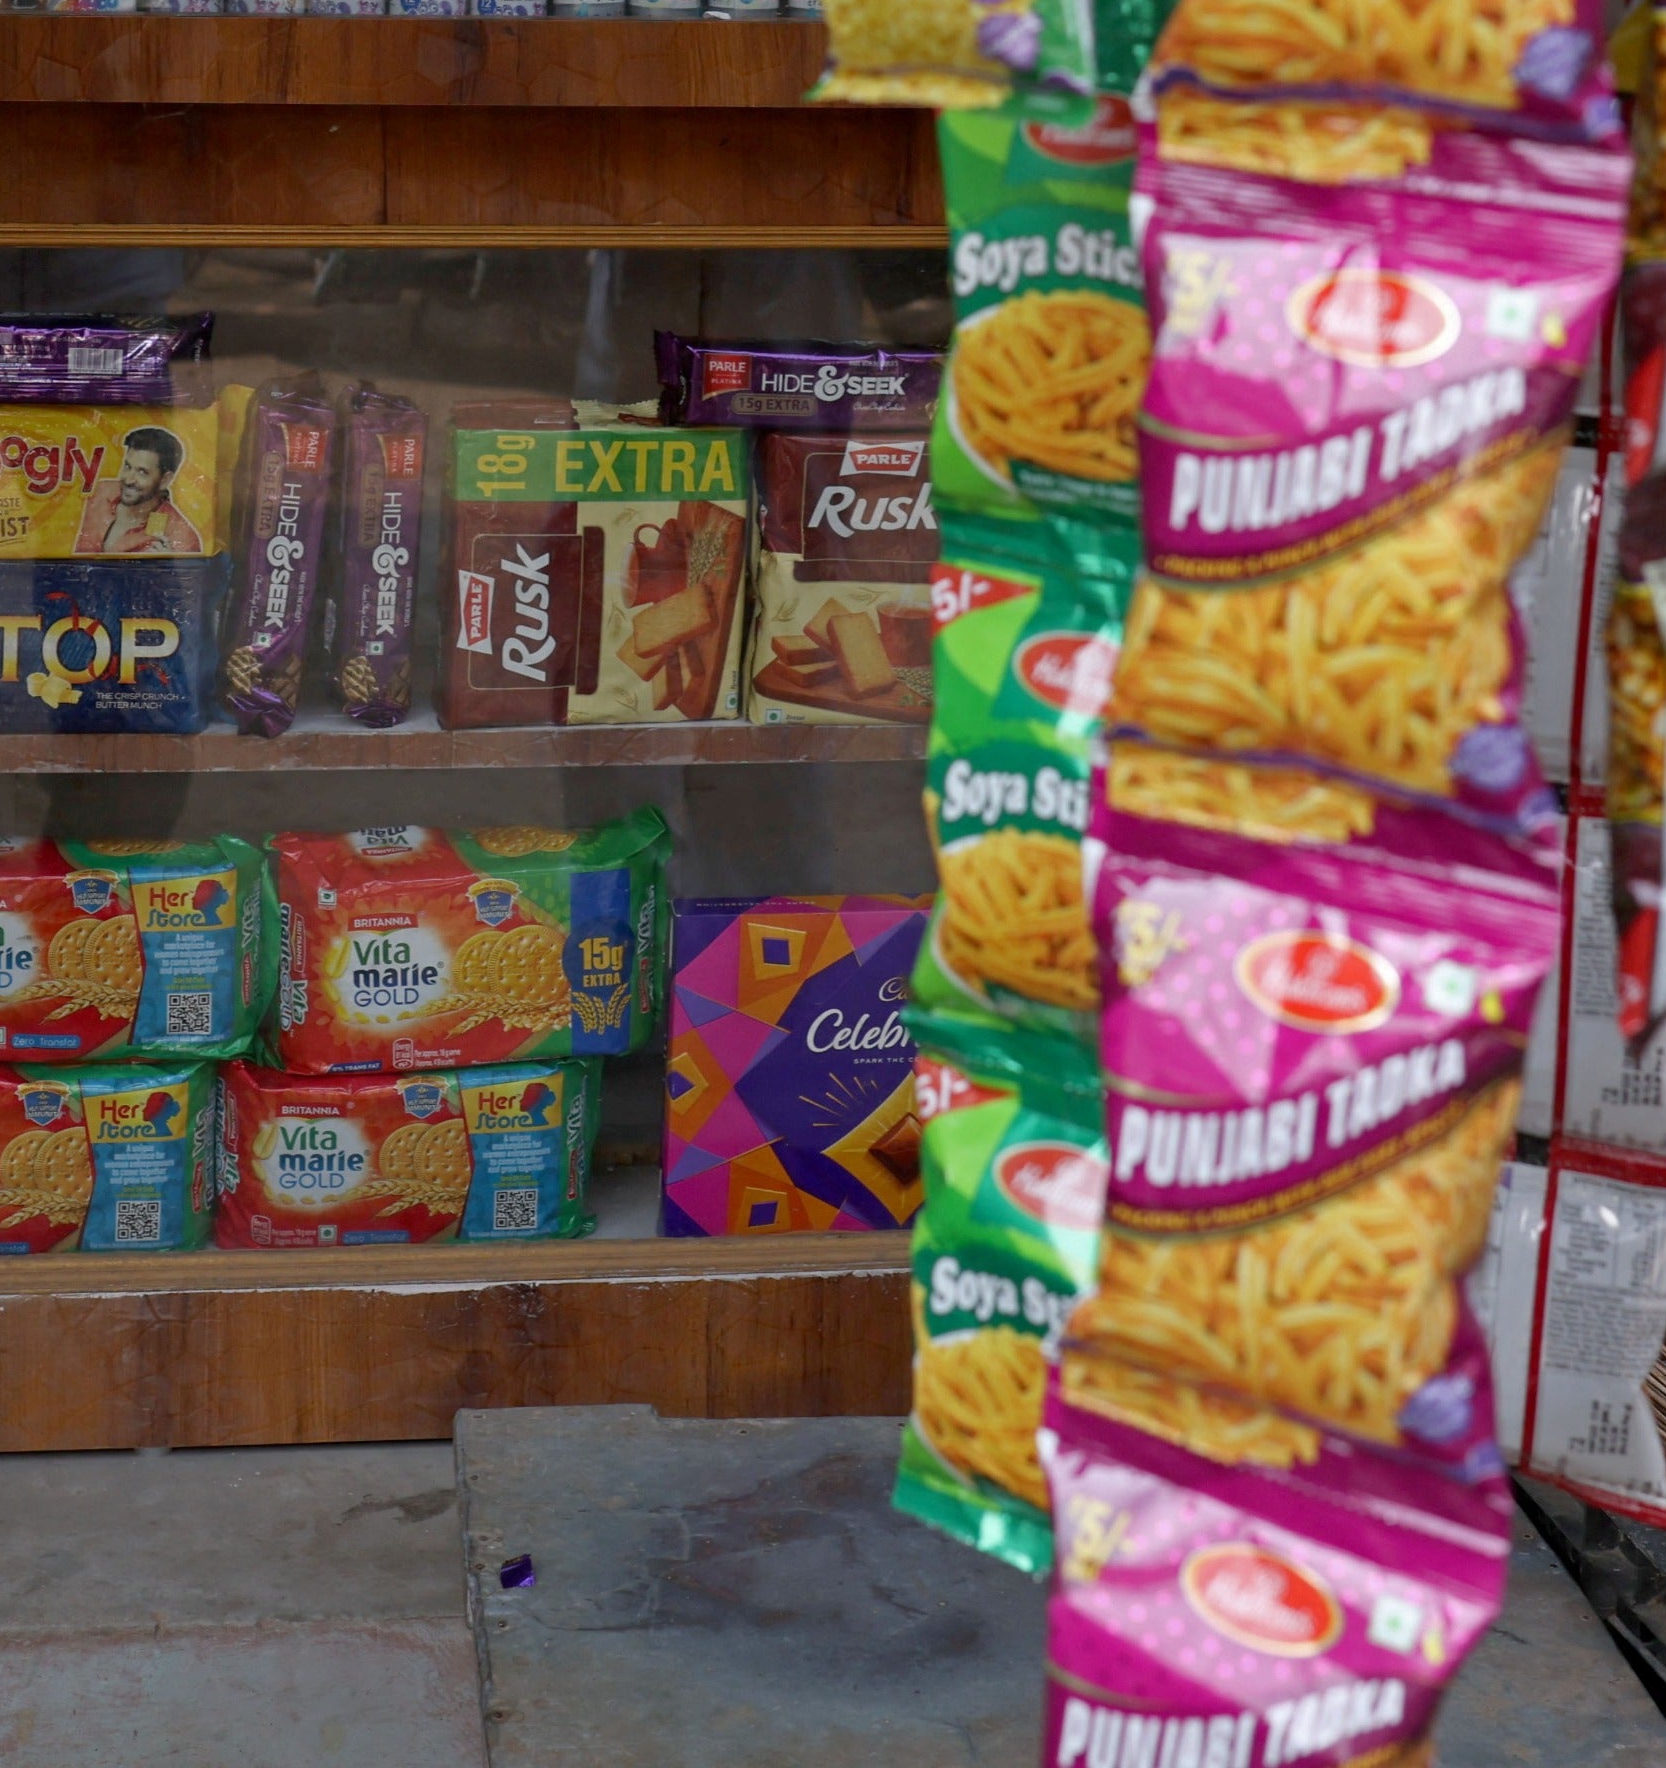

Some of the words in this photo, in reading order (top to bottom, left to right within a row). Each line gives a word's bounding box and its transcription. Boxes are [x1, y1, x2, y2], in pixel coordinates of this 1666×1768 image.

[954, 230, 1050, 297] Soya
[1057, 223, 1142, 280] Stic
[708, 360, 747, 373] PARLE
[739, 397, 763, 411] 15g
[767, 397, 810, 411] EXTRA
[305, 431, 320, 469] PARLE
[403, 438, 415, 476] PARLE
[856, 454, 912, 465] PARLE
[1169, 423, 1376, 536] PUNJABI
[1380, 365, 1529, 479] TADKA
[554, 440, 735, 493] EXTRA
[808, 482, 938, 538] Rusk
[469, 580, 490, 644] PARLE
[499, 542, 553, 684] Rusk
[943, 757, 1028, 823] Soya
[149, 887, 189, 912] Her
[146, 910, 205, 927] Store
[354, 917, 411, 928] BRITANNIA
[352, 940, 411, 966] Vita
[579, 937, 624, 970] 15g
[583, 974, 621, 987] EXTRA
[354, 988, 419, 1007] GOLD
[12, 1036, 36, 1047] Zero
[100, 1100, 140, 1125] Her
[281, 1105, 340, 1115] BRITANNIA
[478, 1092, 517, 1114] Her
[1114, 1094, 1321, 1190] PUNJABI
[1327, 1037, 1469, 1142] TADKA
[96, 1122, 155, 1140] Store
[474, 1112, 533, 1130] Store
[280, 1126, 338, 1152] Vita
[279, 1173, 344, 1189] GOLD
[930, 1255, 1021, 1316] Soya
